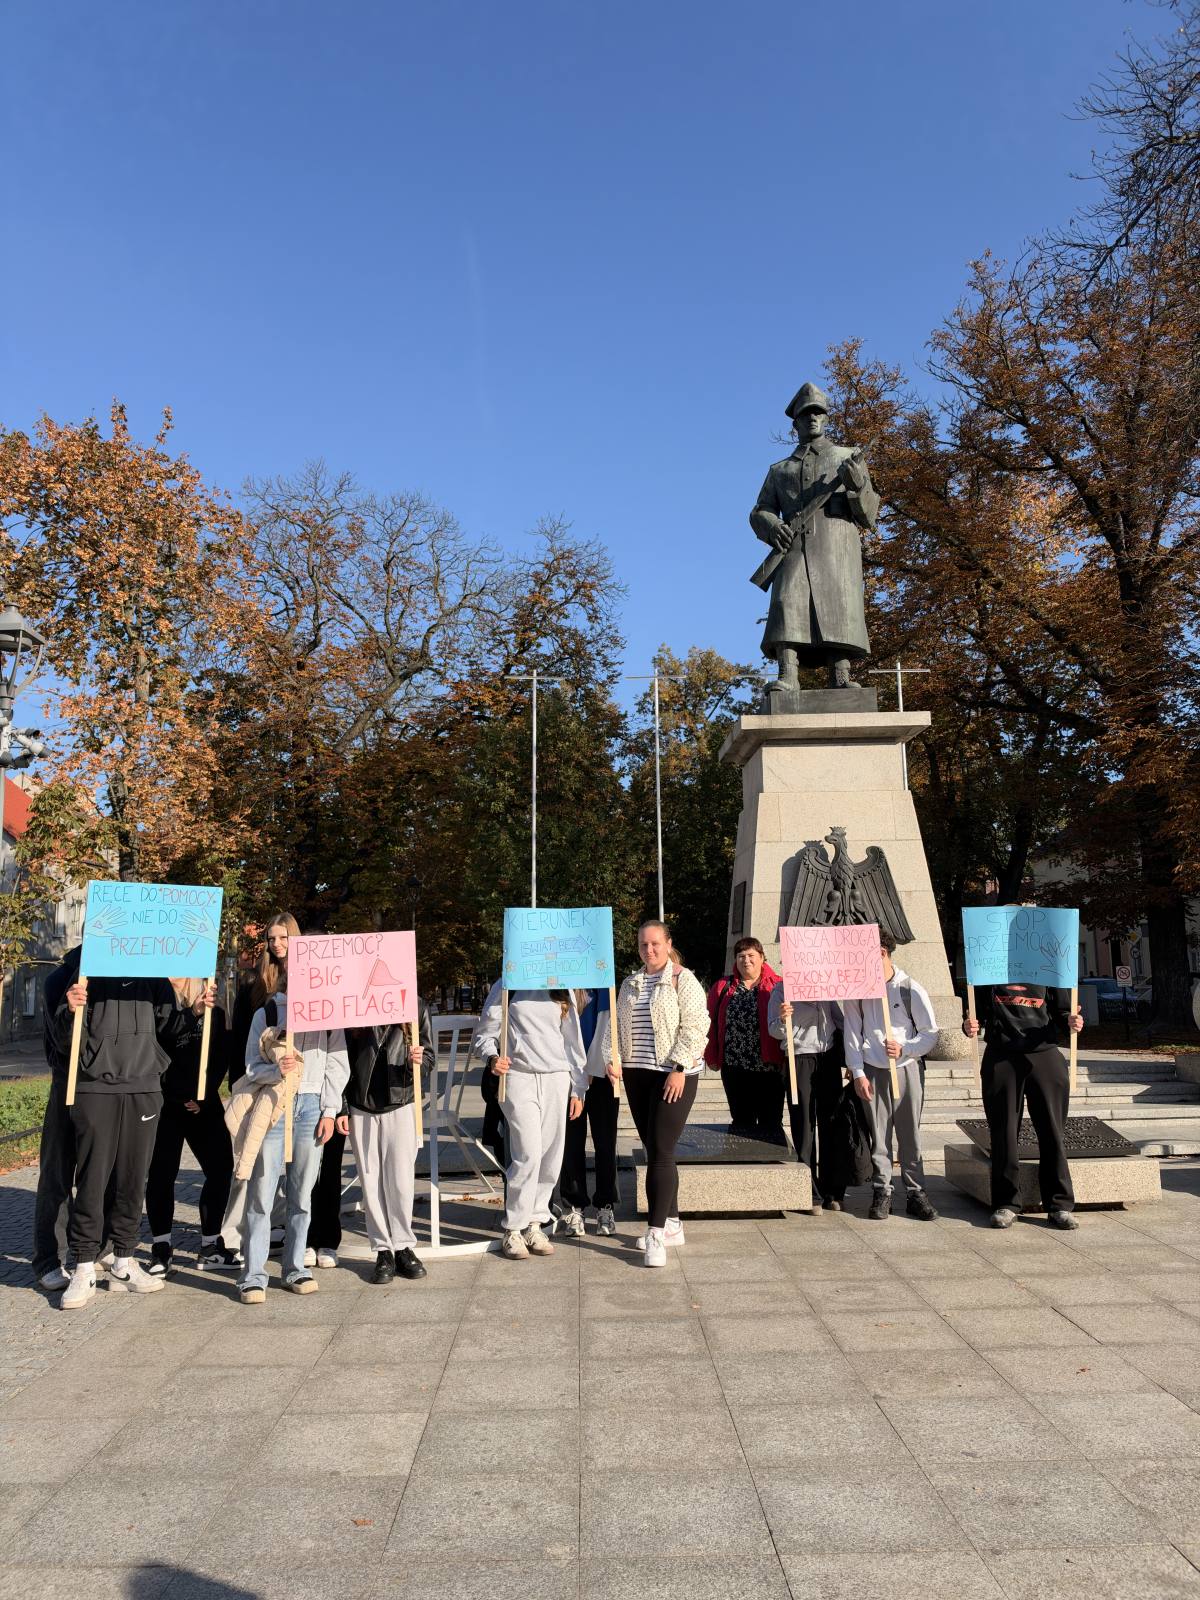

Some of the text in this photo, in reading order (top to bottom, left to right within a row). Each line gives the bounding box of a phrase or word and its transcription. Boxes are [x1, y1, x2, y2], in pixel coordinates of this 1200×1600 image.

[132, 909, 178, 924] NIE DO
[987, 910, 1046, 932] STOP
[110, 937, 200, 957] PRZEMOCY
[296, 934, 383, 962] PRZEMOC?
[785, 928, 876, 952] NASZA DROGA
[968, 932, 1067, 953] PRZEMOCY
[848, 952, 865, 964] DO
[837, 969, 862, 983] BEZ
[792, 985, 851, 999] PRZEMOCY
[293, 1000, 334, 1022] RED
